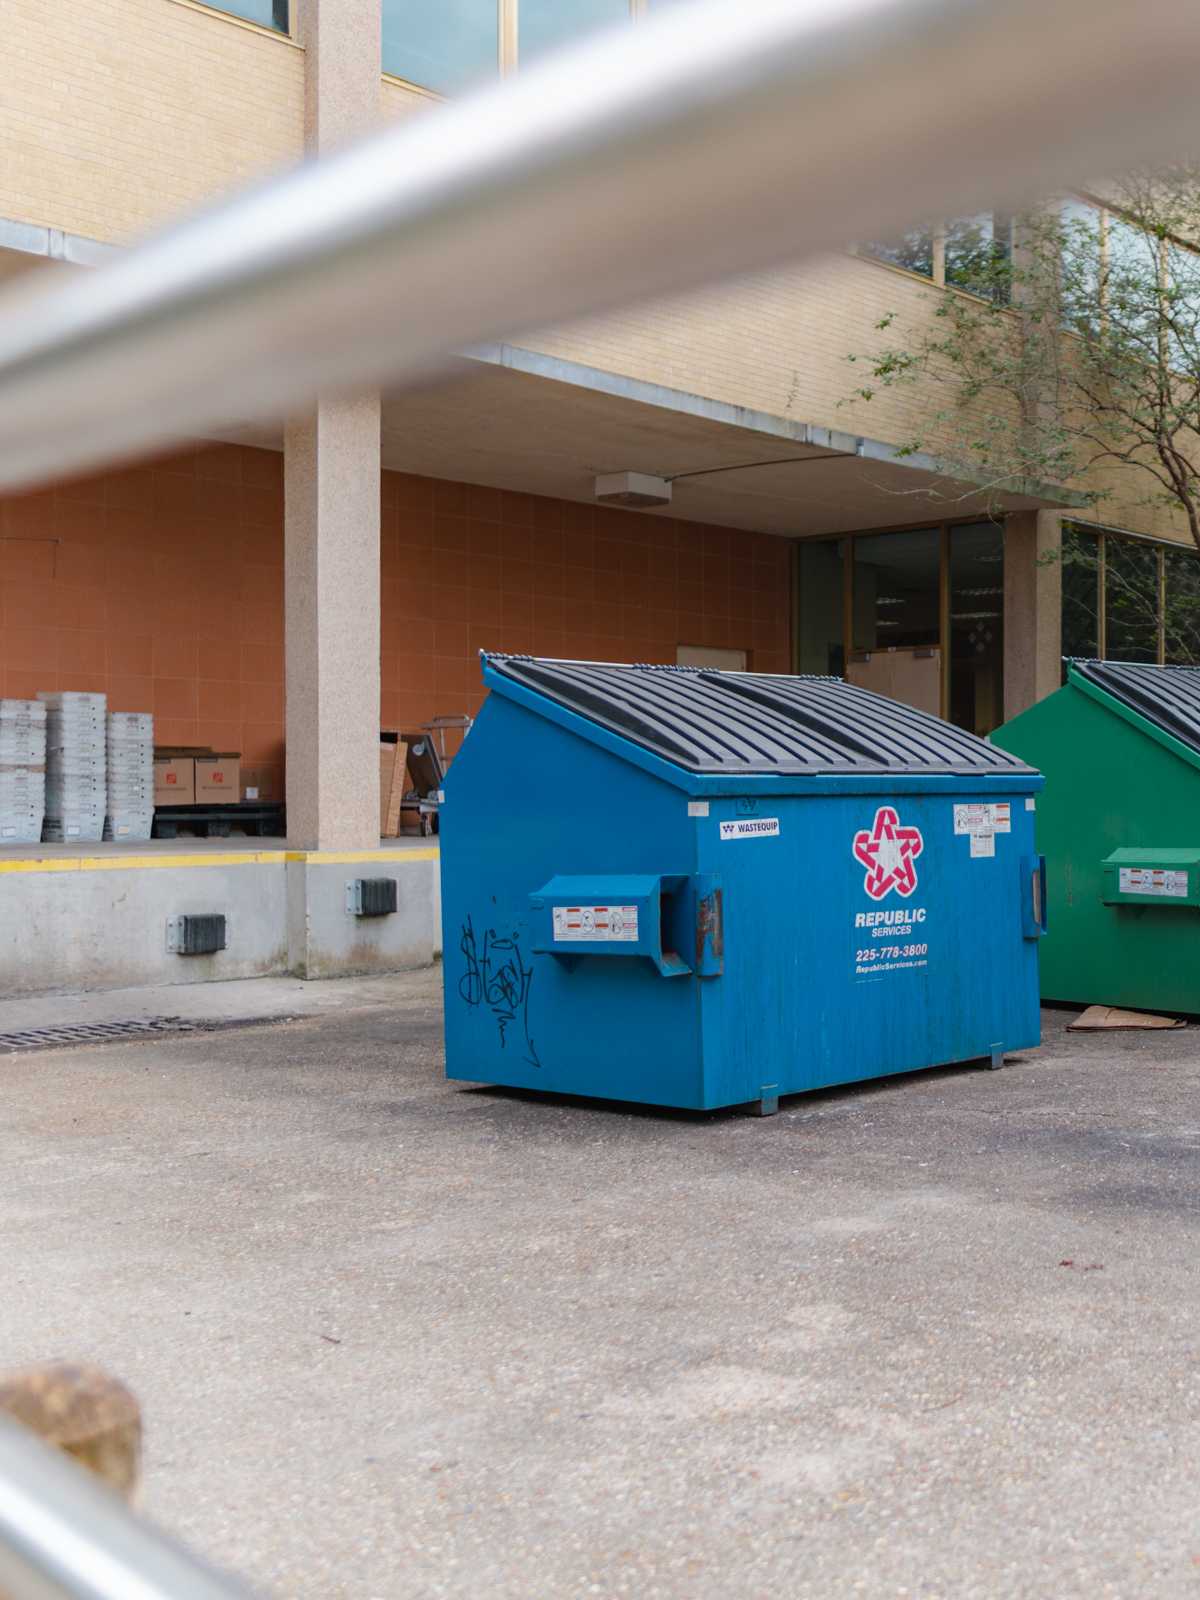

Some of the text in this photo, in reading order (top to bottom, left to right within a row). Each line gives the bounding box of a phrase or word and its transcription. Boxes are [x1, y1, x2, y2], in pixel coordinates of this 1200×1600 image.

[737, 821, 777, 833] WASTEQUIP
[854, 908, 927, 928] REPUBLIC
[872, 925, 912, 938] SERVICES
[855, 943, 928, 962] 225-778-3800
